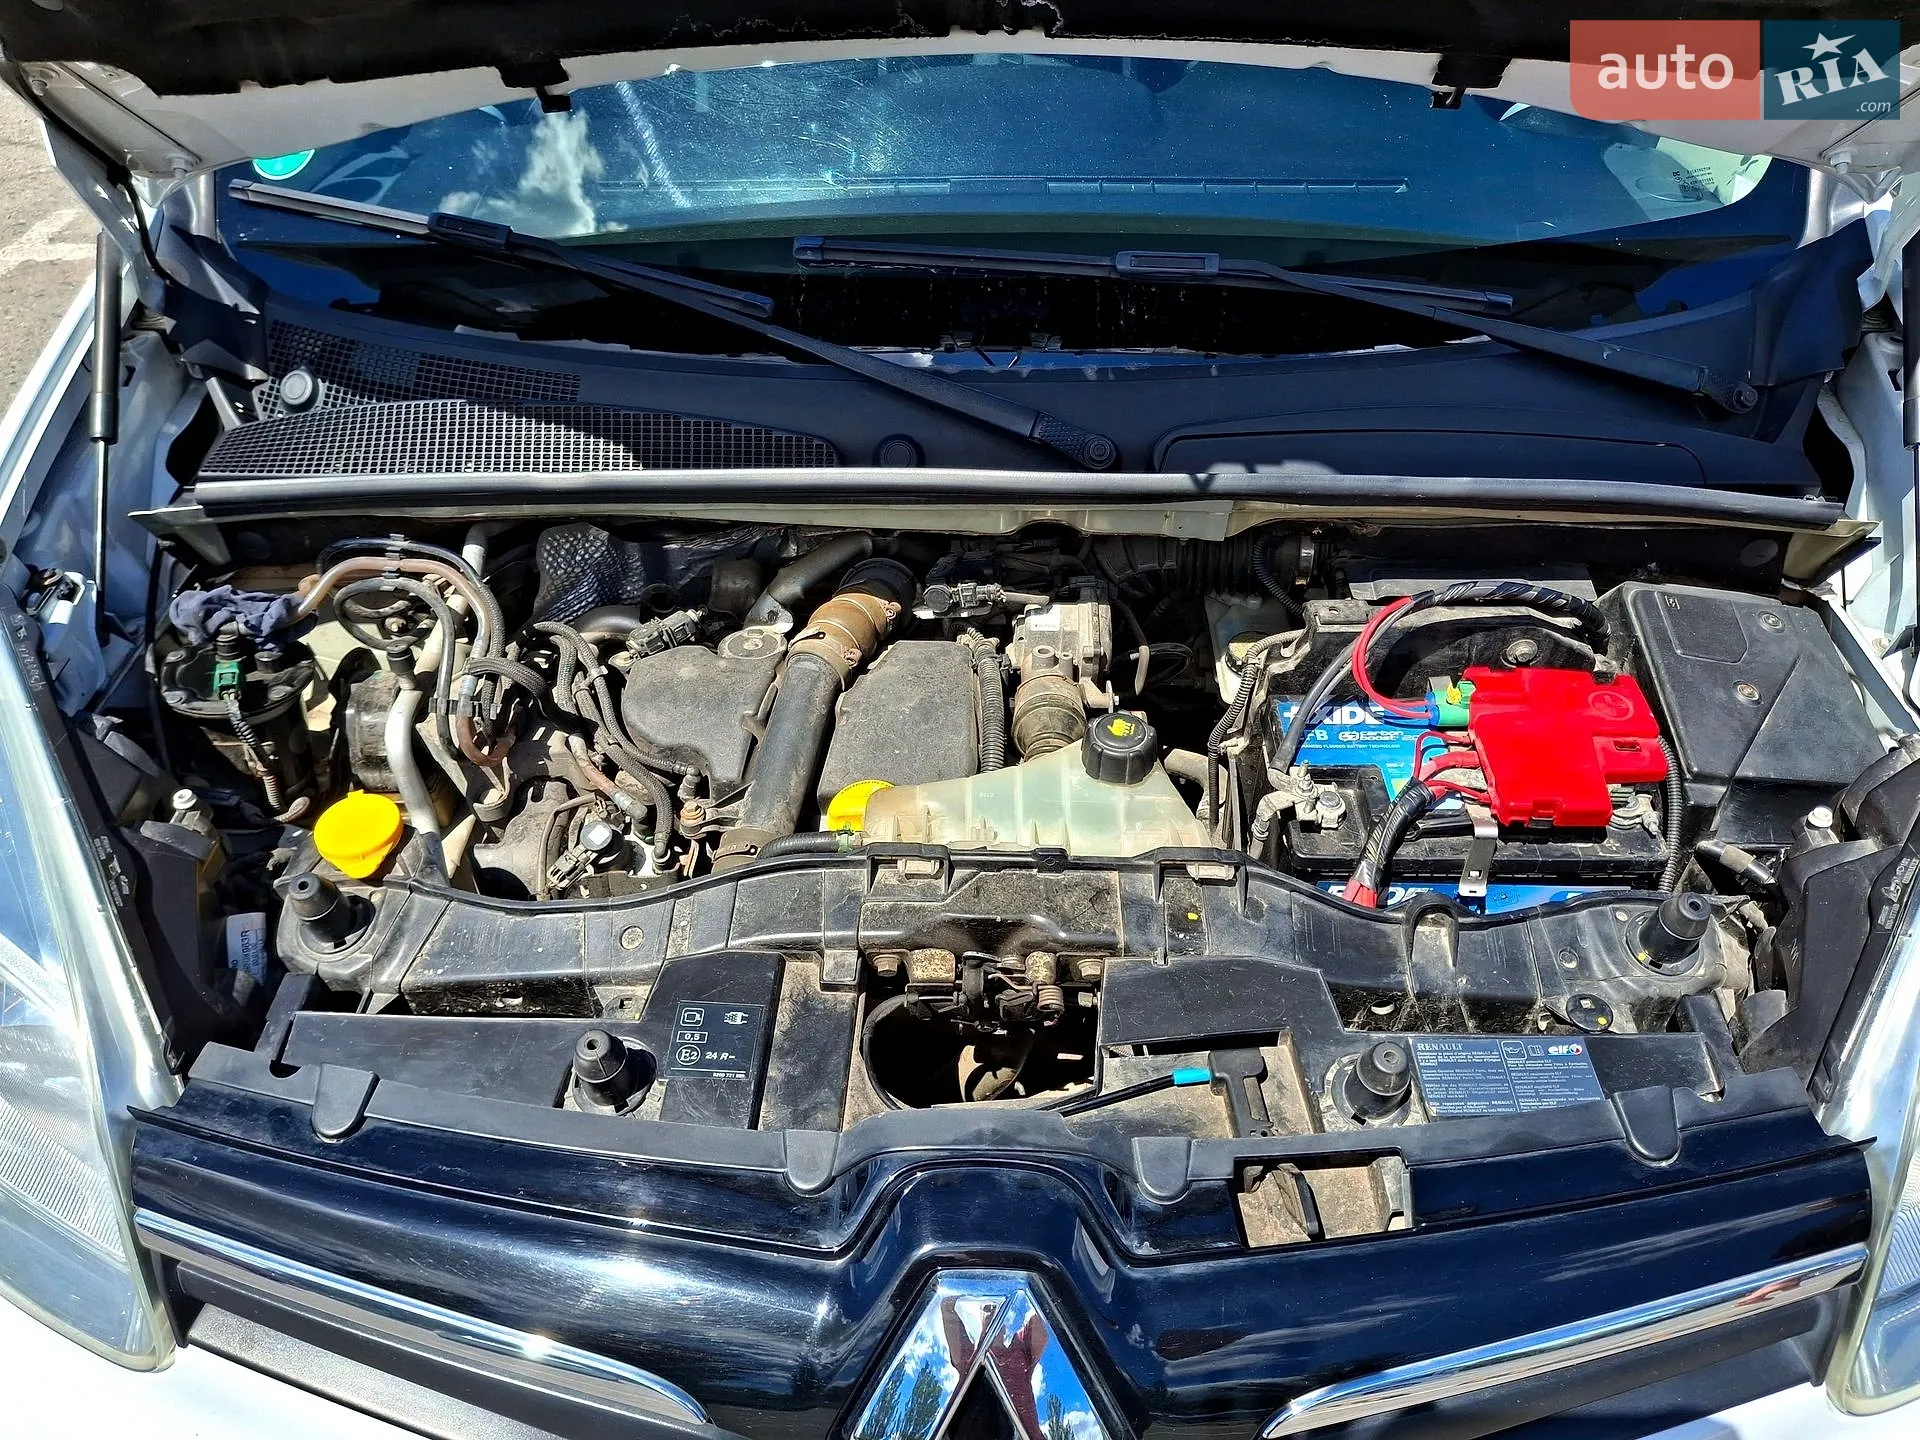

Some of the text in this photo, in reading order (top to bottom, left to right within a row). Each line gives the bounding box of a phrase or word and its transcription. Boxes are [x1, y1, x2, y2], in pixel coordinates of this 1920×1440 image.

[684, 1033, 700, 1041] 0,5
[1416, 1043, 1464, 1051] RENAULT
[680, 1049, 698, 1061] E2
[705, 1052, 718, 1060] 24
